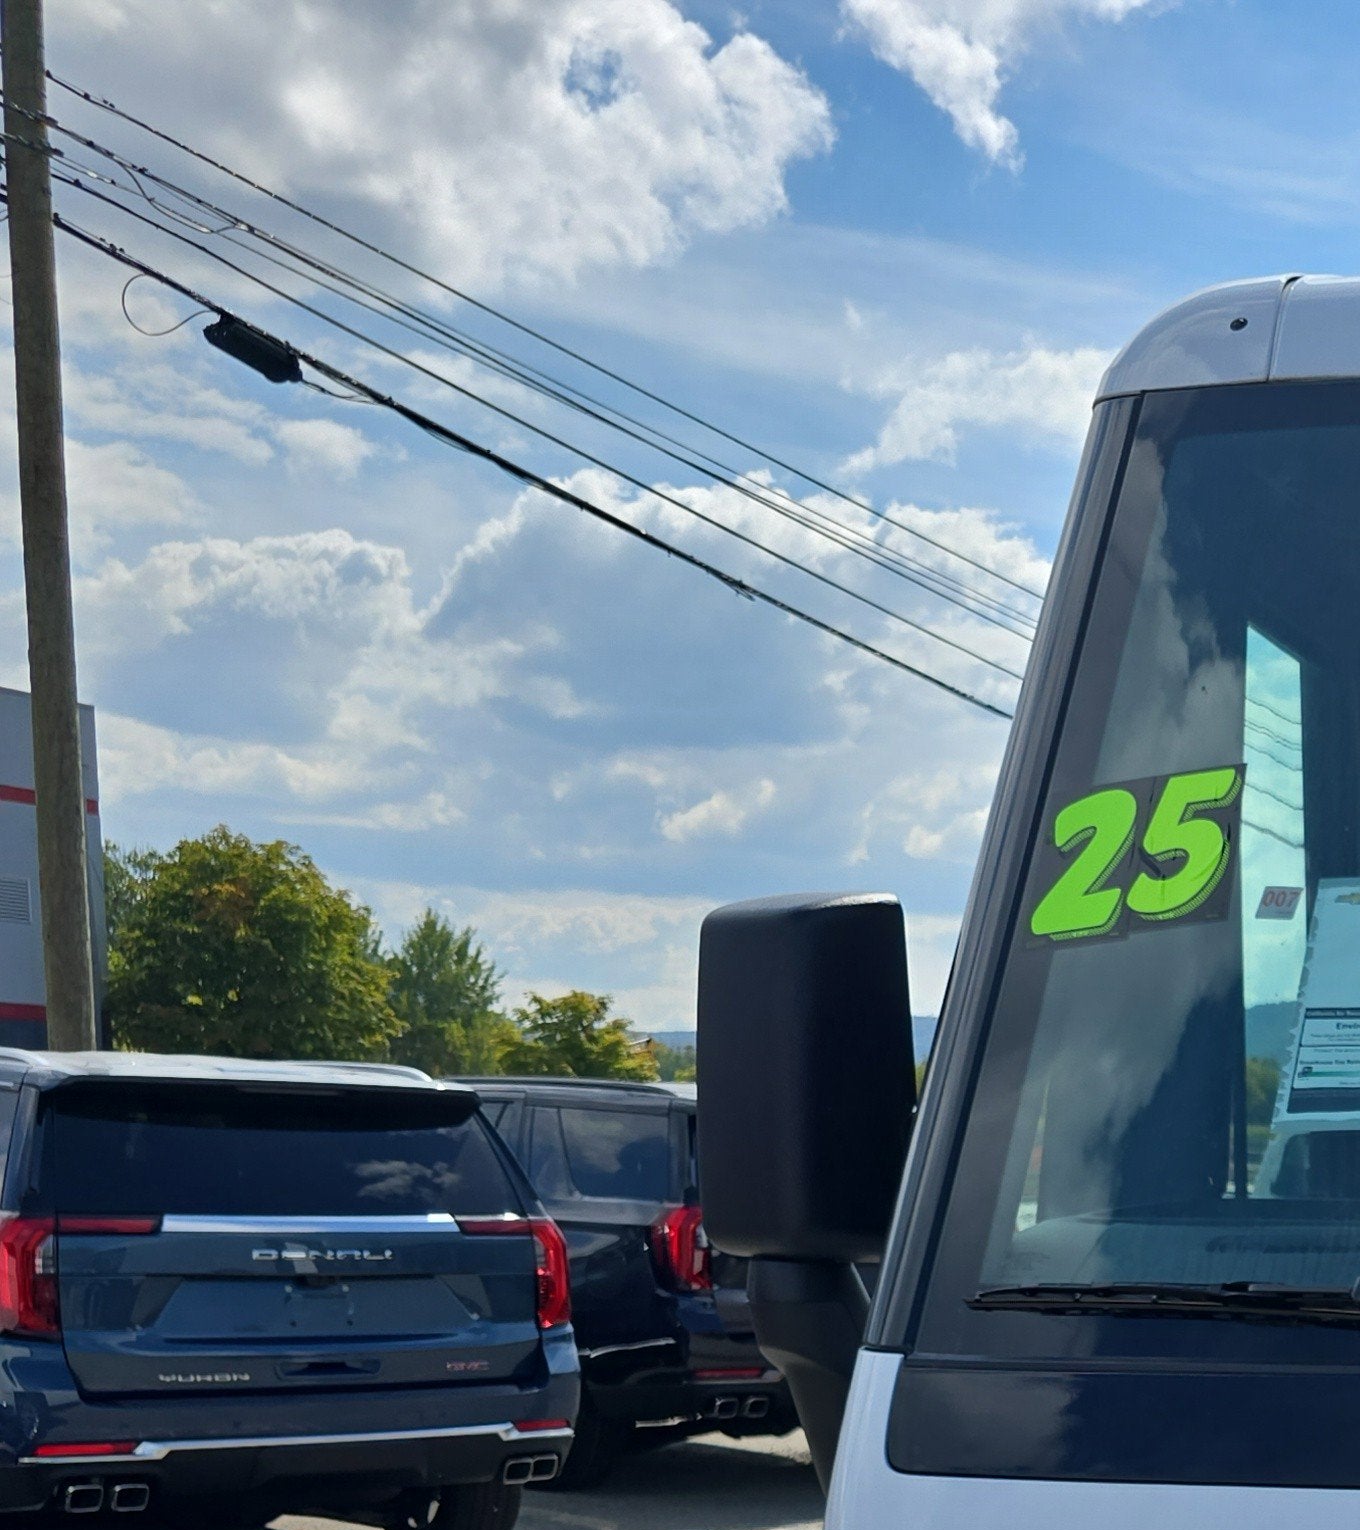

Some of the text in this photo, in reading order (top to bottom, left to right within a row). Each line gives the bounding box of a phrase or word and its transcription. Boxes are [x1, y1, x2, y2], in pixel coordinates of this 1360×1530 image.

[1031, 768, 1241, 940] 25
[1263, 891, 1301, 907] 007
[252, 1249, 393, 1260] DENALI
[159, 1373, 250, 1382] YUKON
